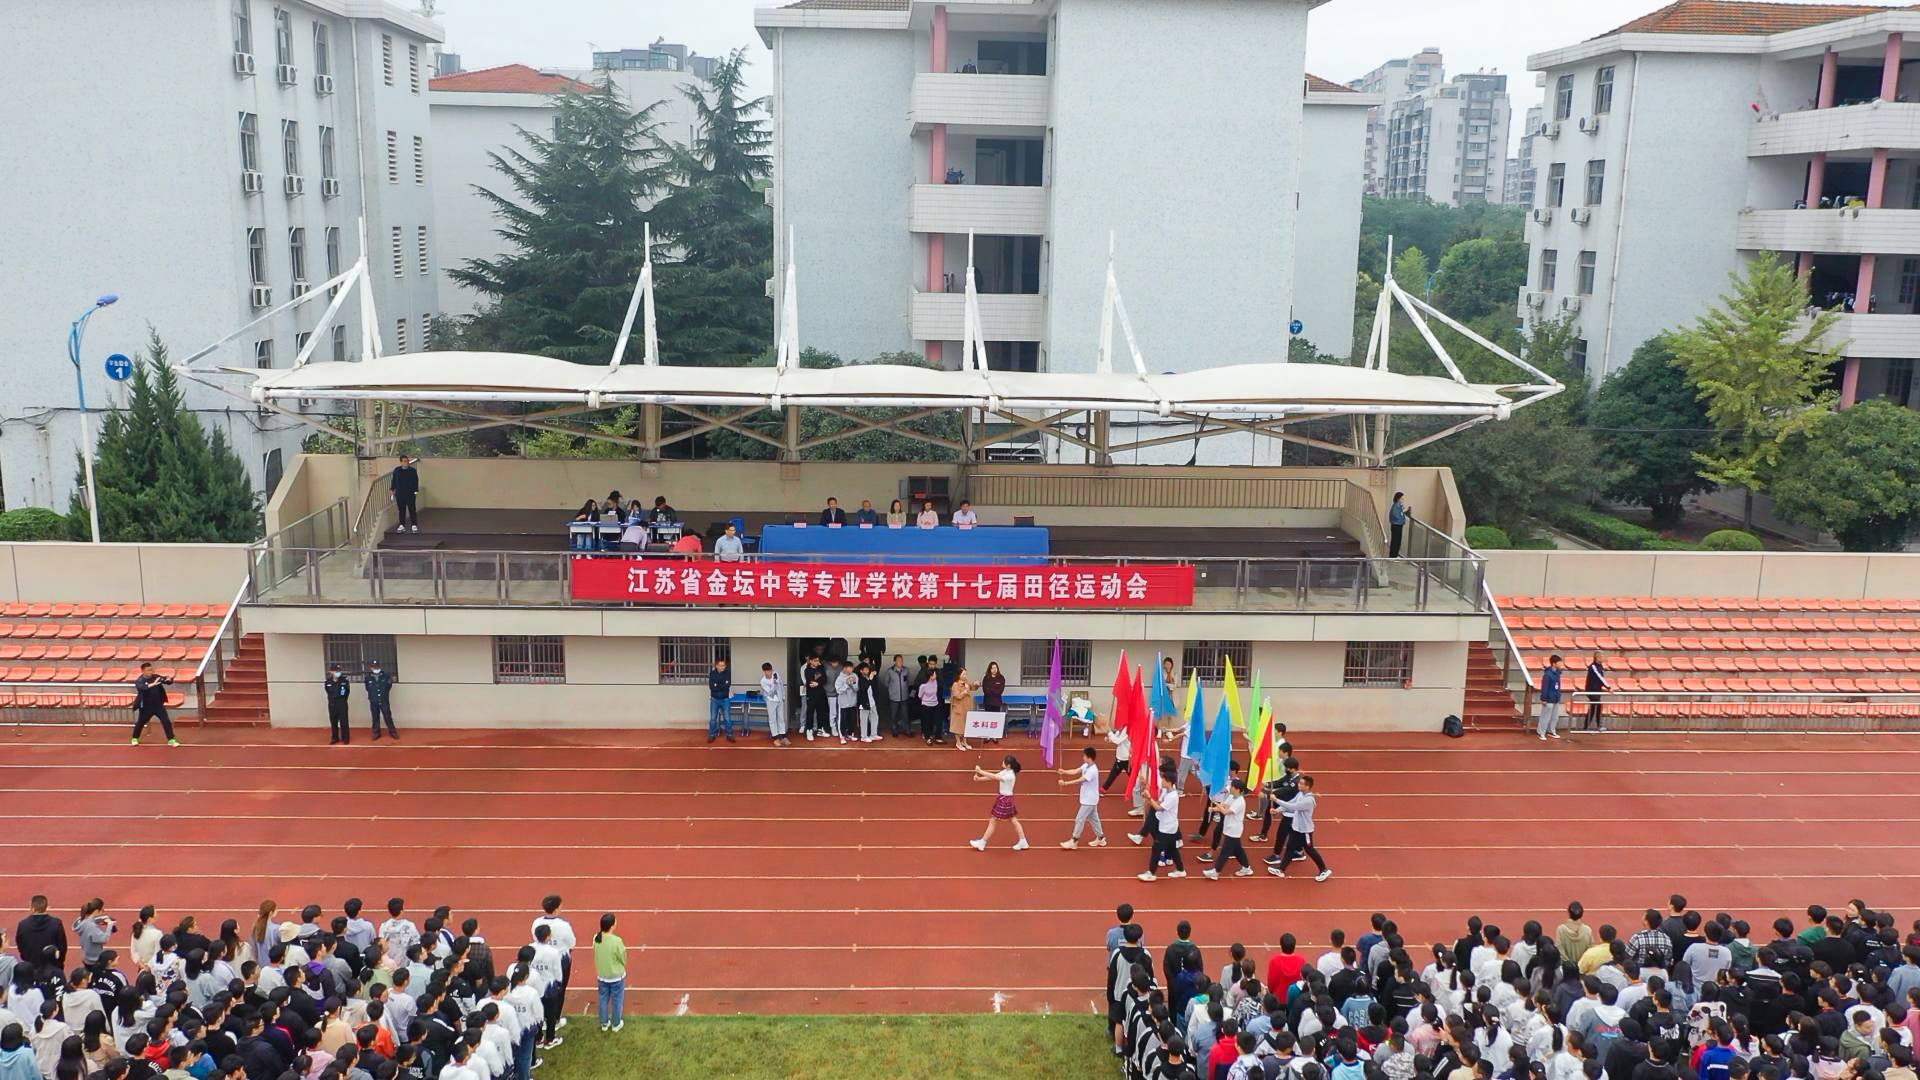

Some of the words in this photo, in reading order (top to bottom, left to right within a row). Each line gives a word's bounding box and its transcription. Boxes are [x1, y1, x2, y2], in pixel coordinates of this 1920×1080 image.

[115, 367, 123, 379] 1
[627, 567, 1148, 600] 江苏省金坛中等专业学校第十七届田径运动会
